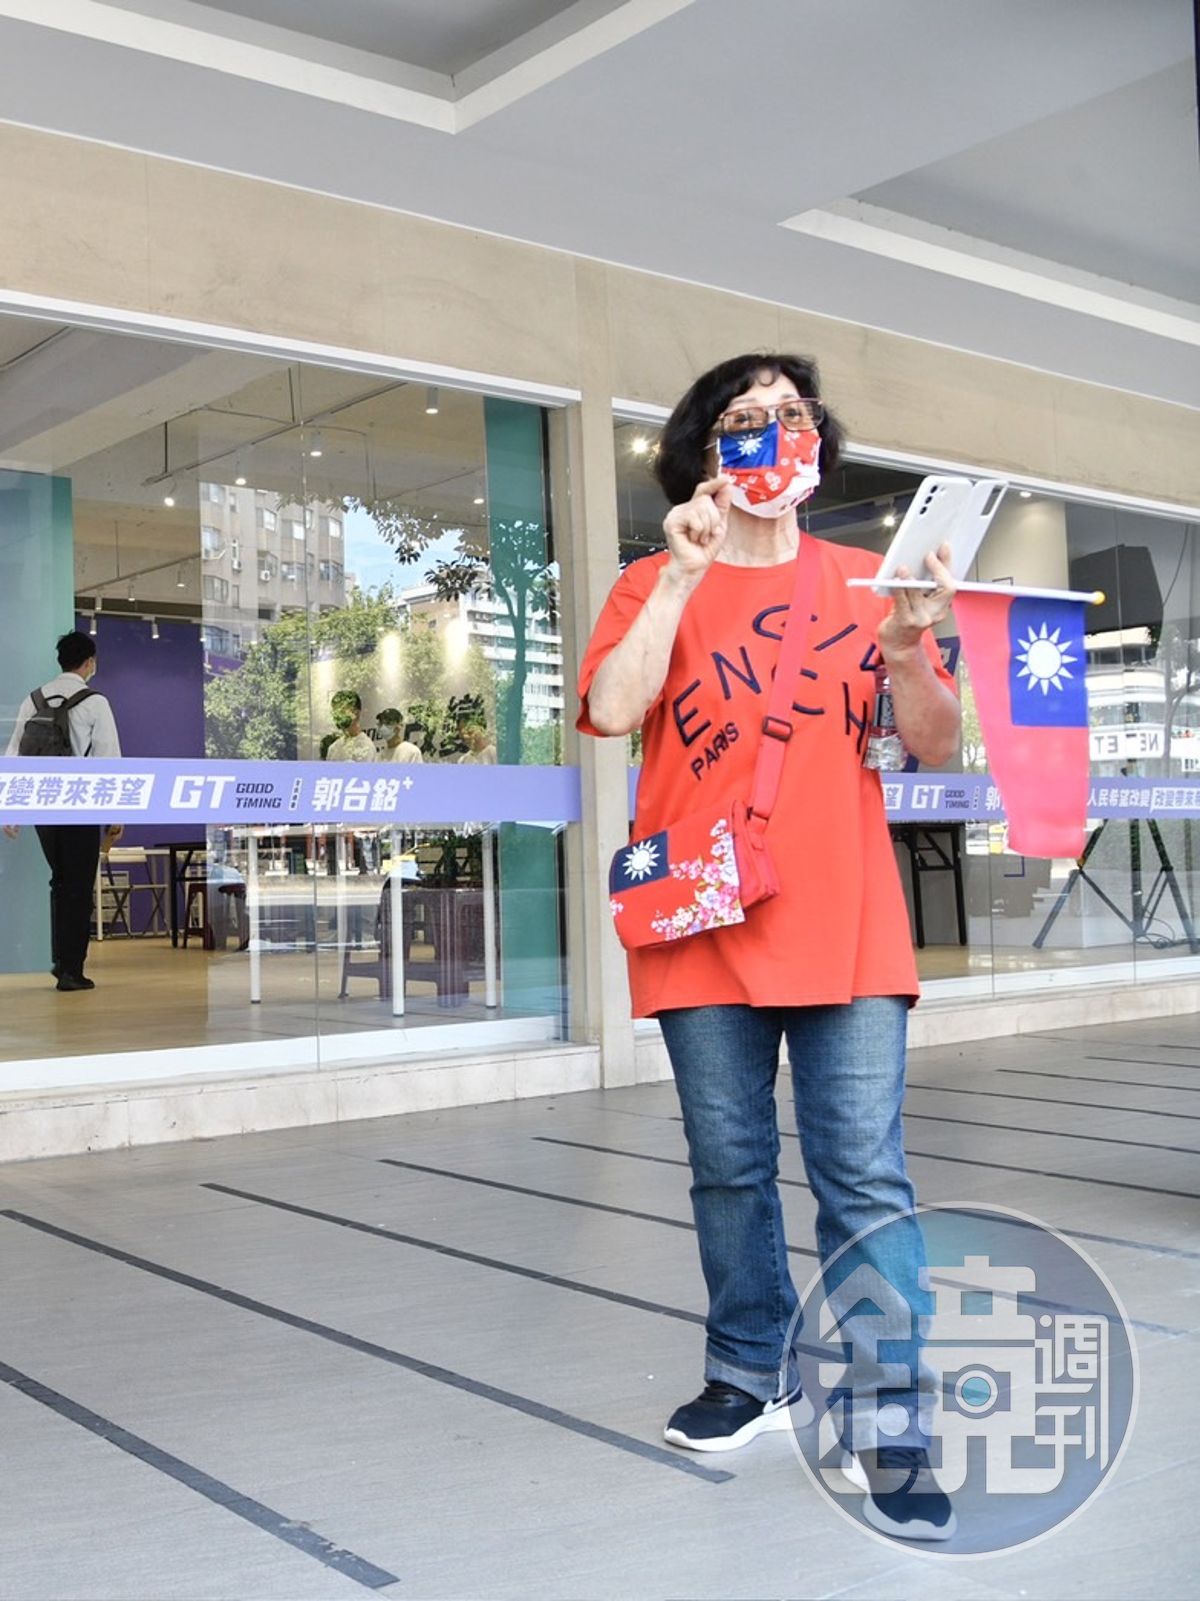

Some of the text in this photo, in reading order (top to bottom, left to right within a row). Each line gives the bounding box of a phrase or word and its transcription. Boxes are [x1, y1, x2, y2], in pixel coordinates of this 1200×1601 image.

[690, 721, 740, 781] PARIS
[169, 775, 236, 809] GT
[235, 783, 275, 794] GOOD
[910, 784, 945, 810] GT
[984, 785, 1004, 812] 郭
